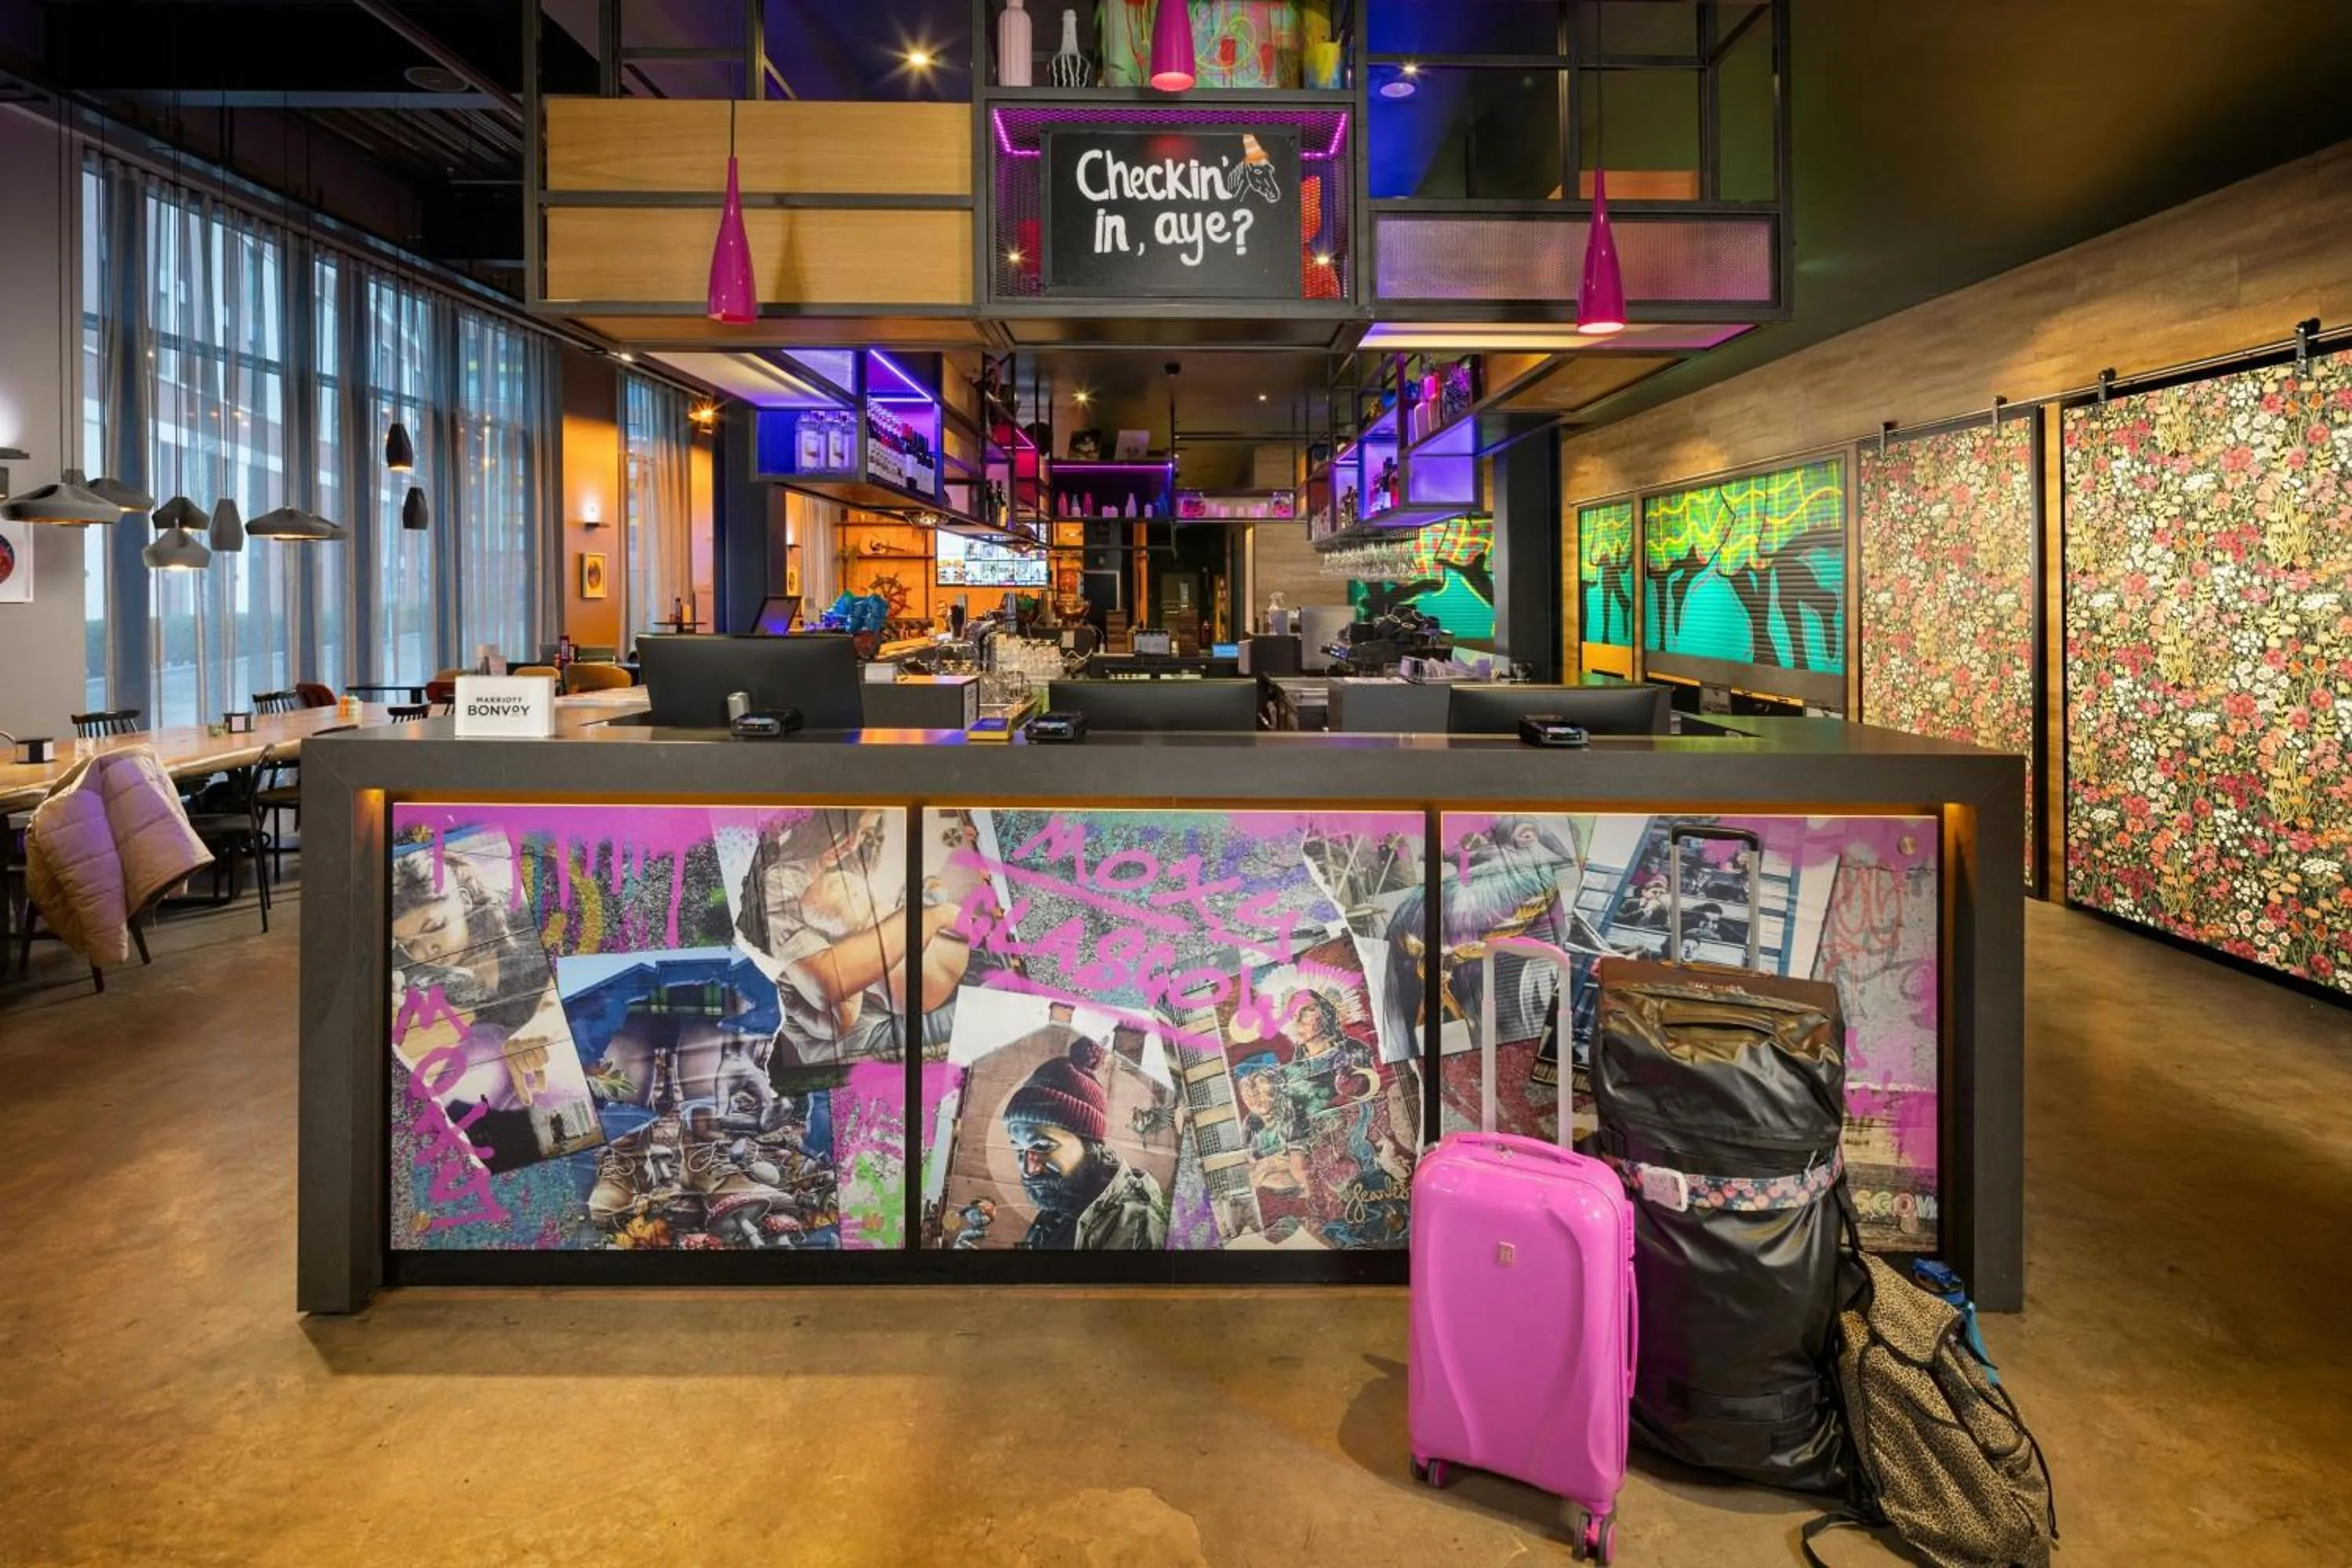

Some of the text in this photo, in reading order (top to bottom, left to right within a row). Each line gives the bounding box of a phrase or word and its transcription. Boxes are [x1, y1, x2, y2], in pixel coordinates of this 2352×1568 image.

[1076, 149, 1233, 201] Checkin'
[1154, 208, 1254, 266] aye?
[955, 884, 1314, 1040] GLASGOW
[1851, 1189, 1938, 1218] SGOW
